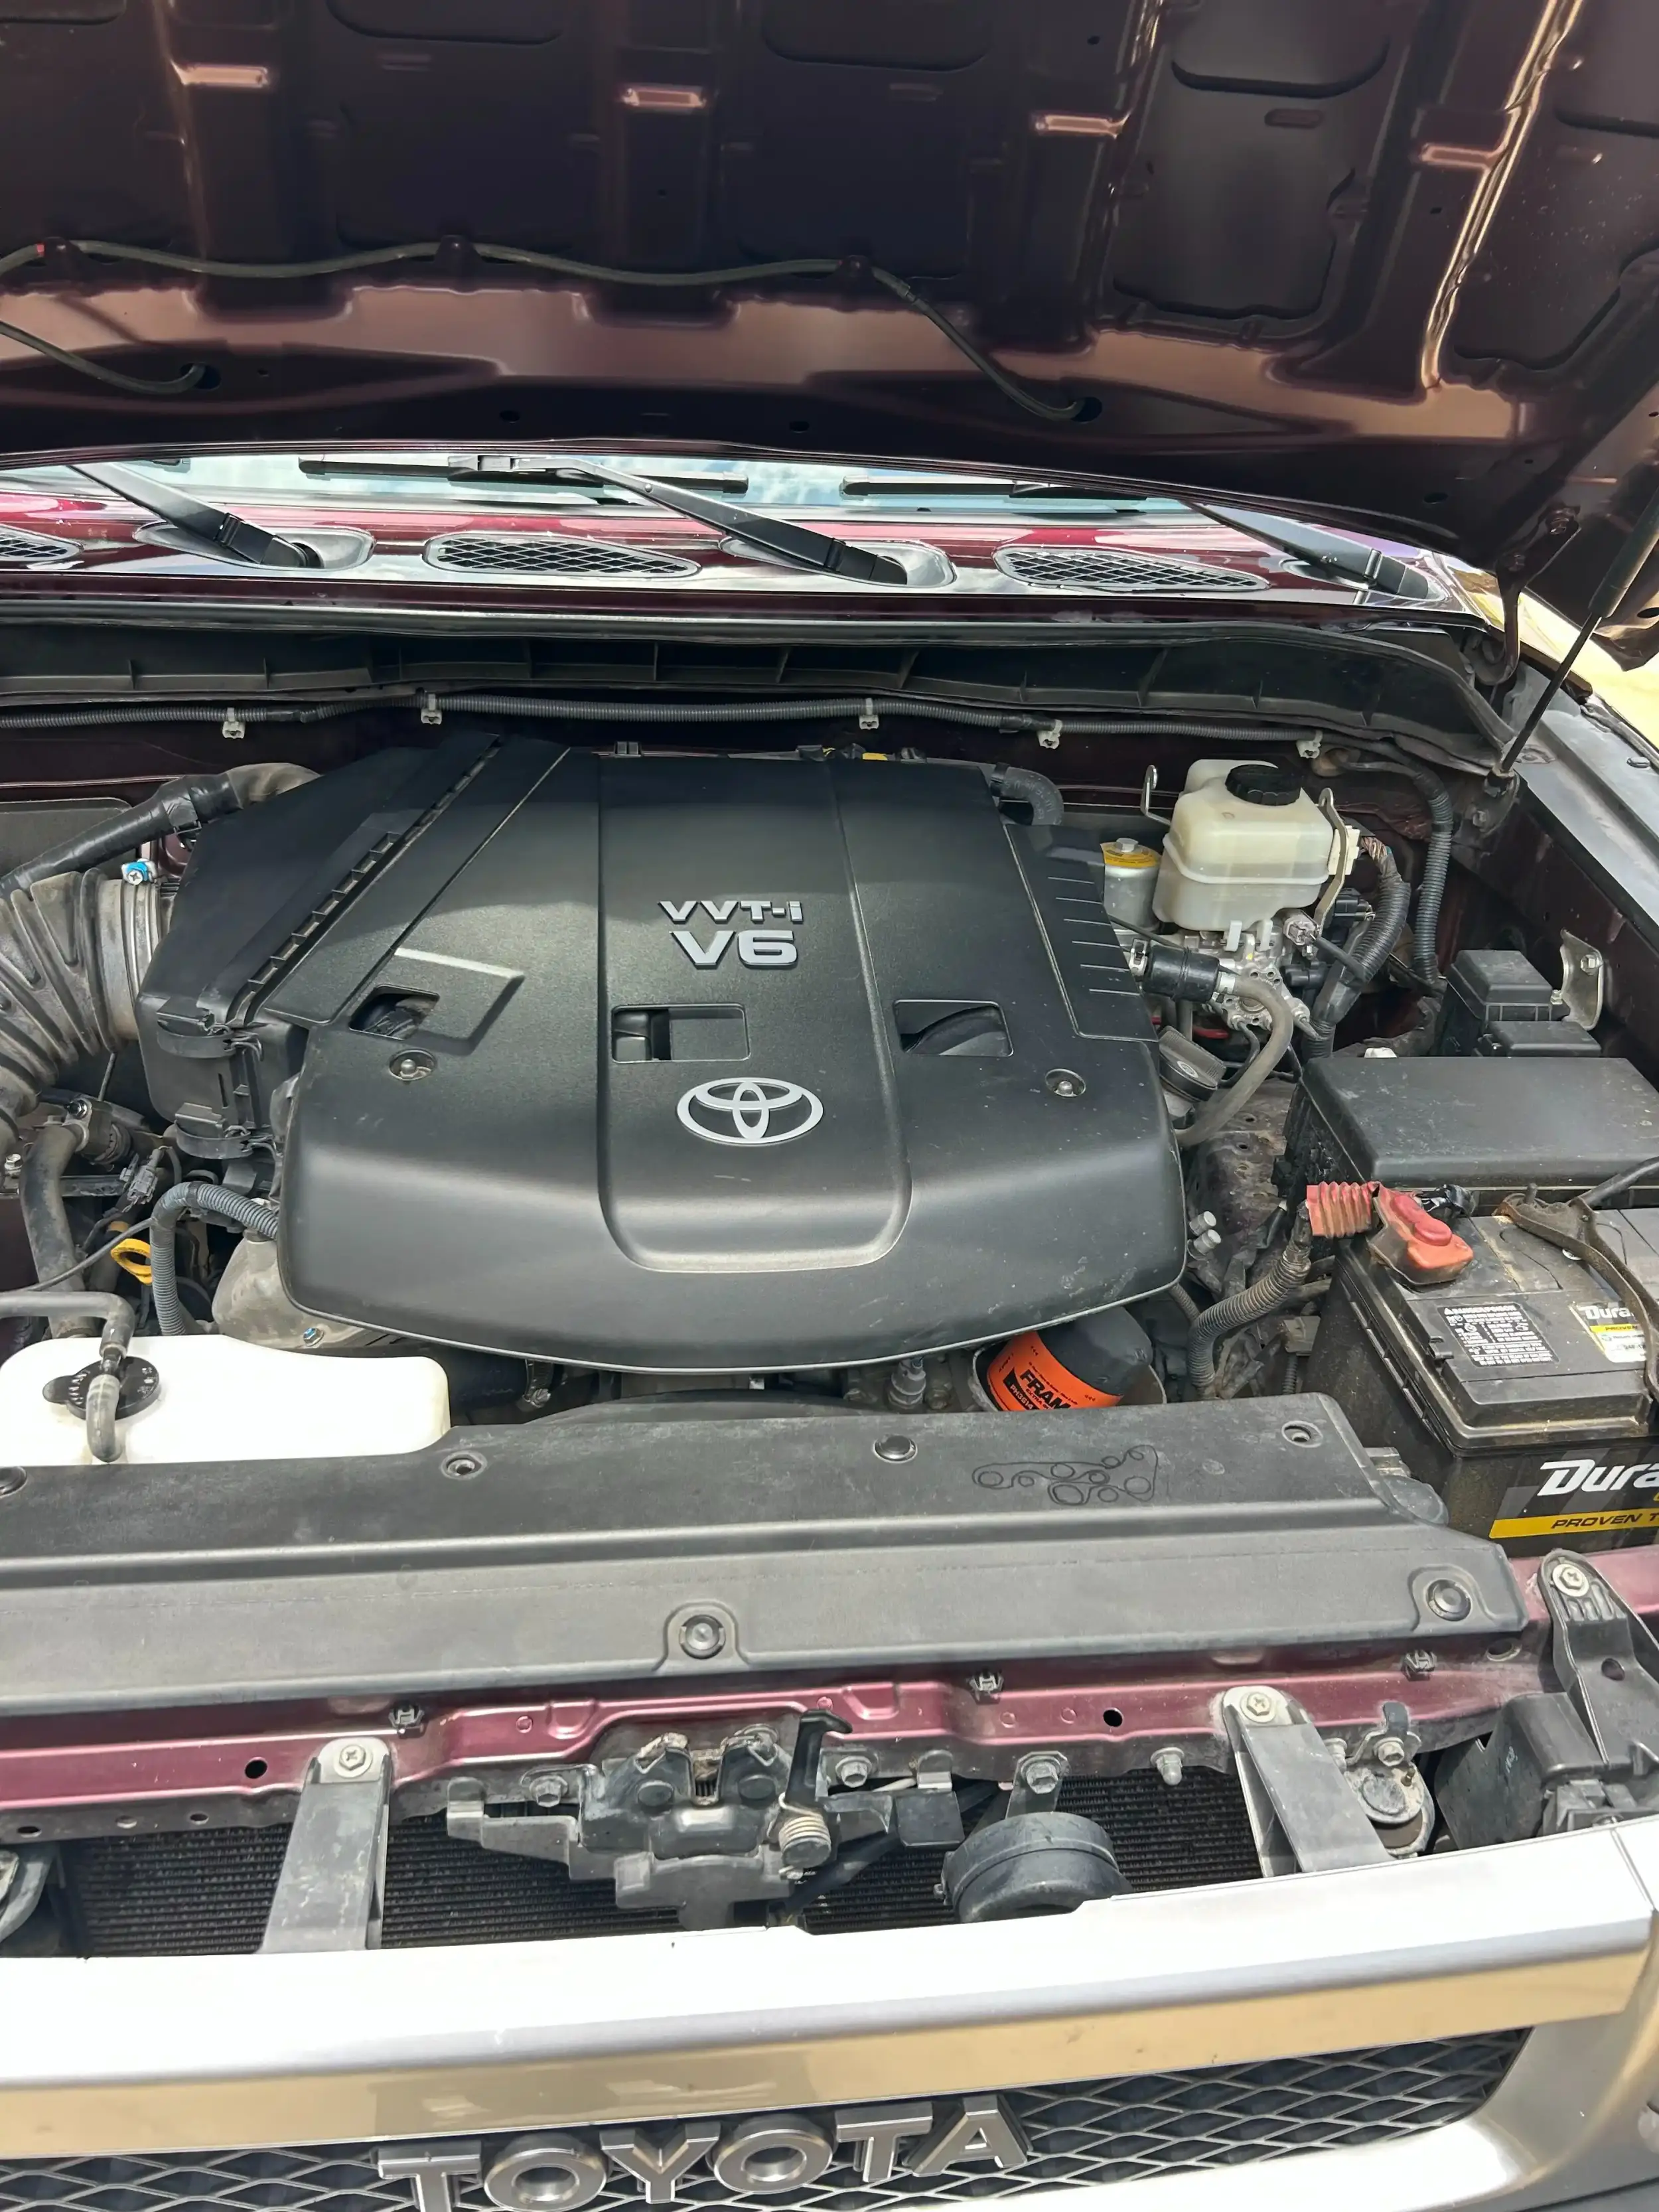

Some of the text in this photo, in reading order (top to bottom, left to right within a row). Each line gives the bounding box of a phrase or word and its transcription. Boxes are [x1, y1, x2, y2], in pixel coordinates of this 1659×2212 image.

[669, 929, 798, 966] V6
[1019, 1368, 1072, 1410] FRAM
[1550, 1513, 1643, 1529] PROVEN
[377, 2095, 1030, 2212] TOYOTA
